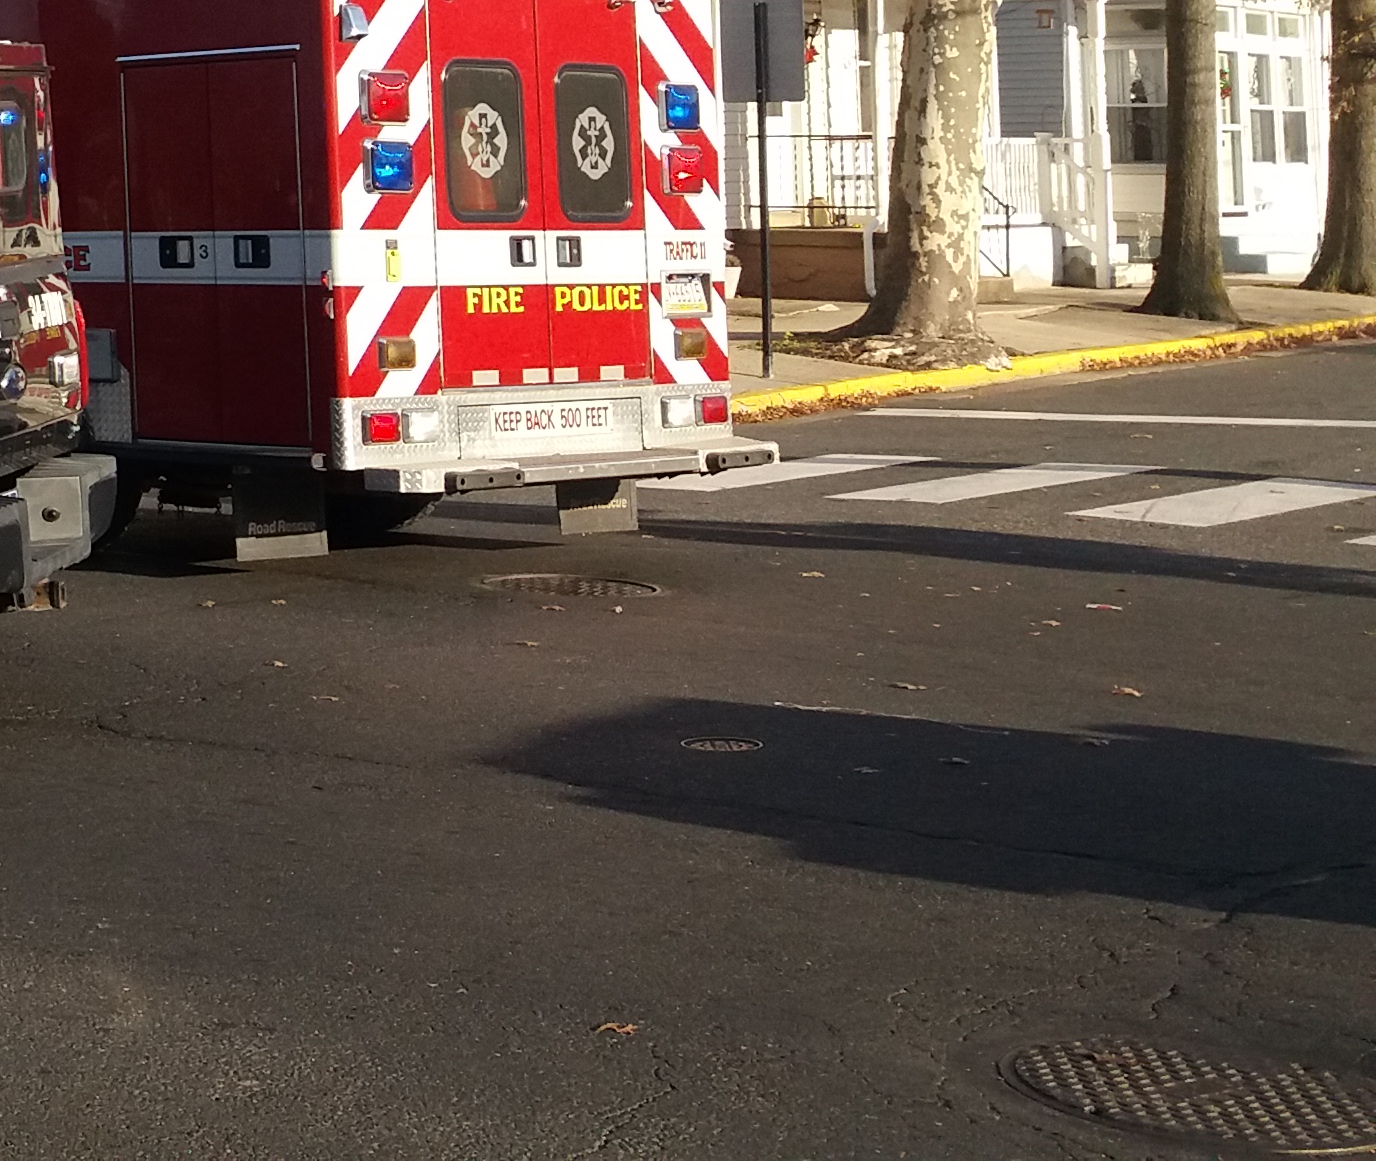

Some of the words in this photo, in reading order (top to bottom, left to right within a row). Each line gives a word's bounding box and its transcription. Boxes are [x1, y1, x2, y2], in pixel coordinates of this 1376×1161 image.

[198, 244, 209, 259] 3
[664, 241, 698, 260] TRAFFIC
[700, 241, 707, 260] 11
[466, 286, 524, 314] FIRE
[554, 285, 644, 312] POLICE
[494, 411, 522, 432] KEEP
[526, 409, 555, 430] BACK
[560, 407, 582, 428] 500
[586, 406, 609, 427] FEET
[248, 520, 277, 535] Road
